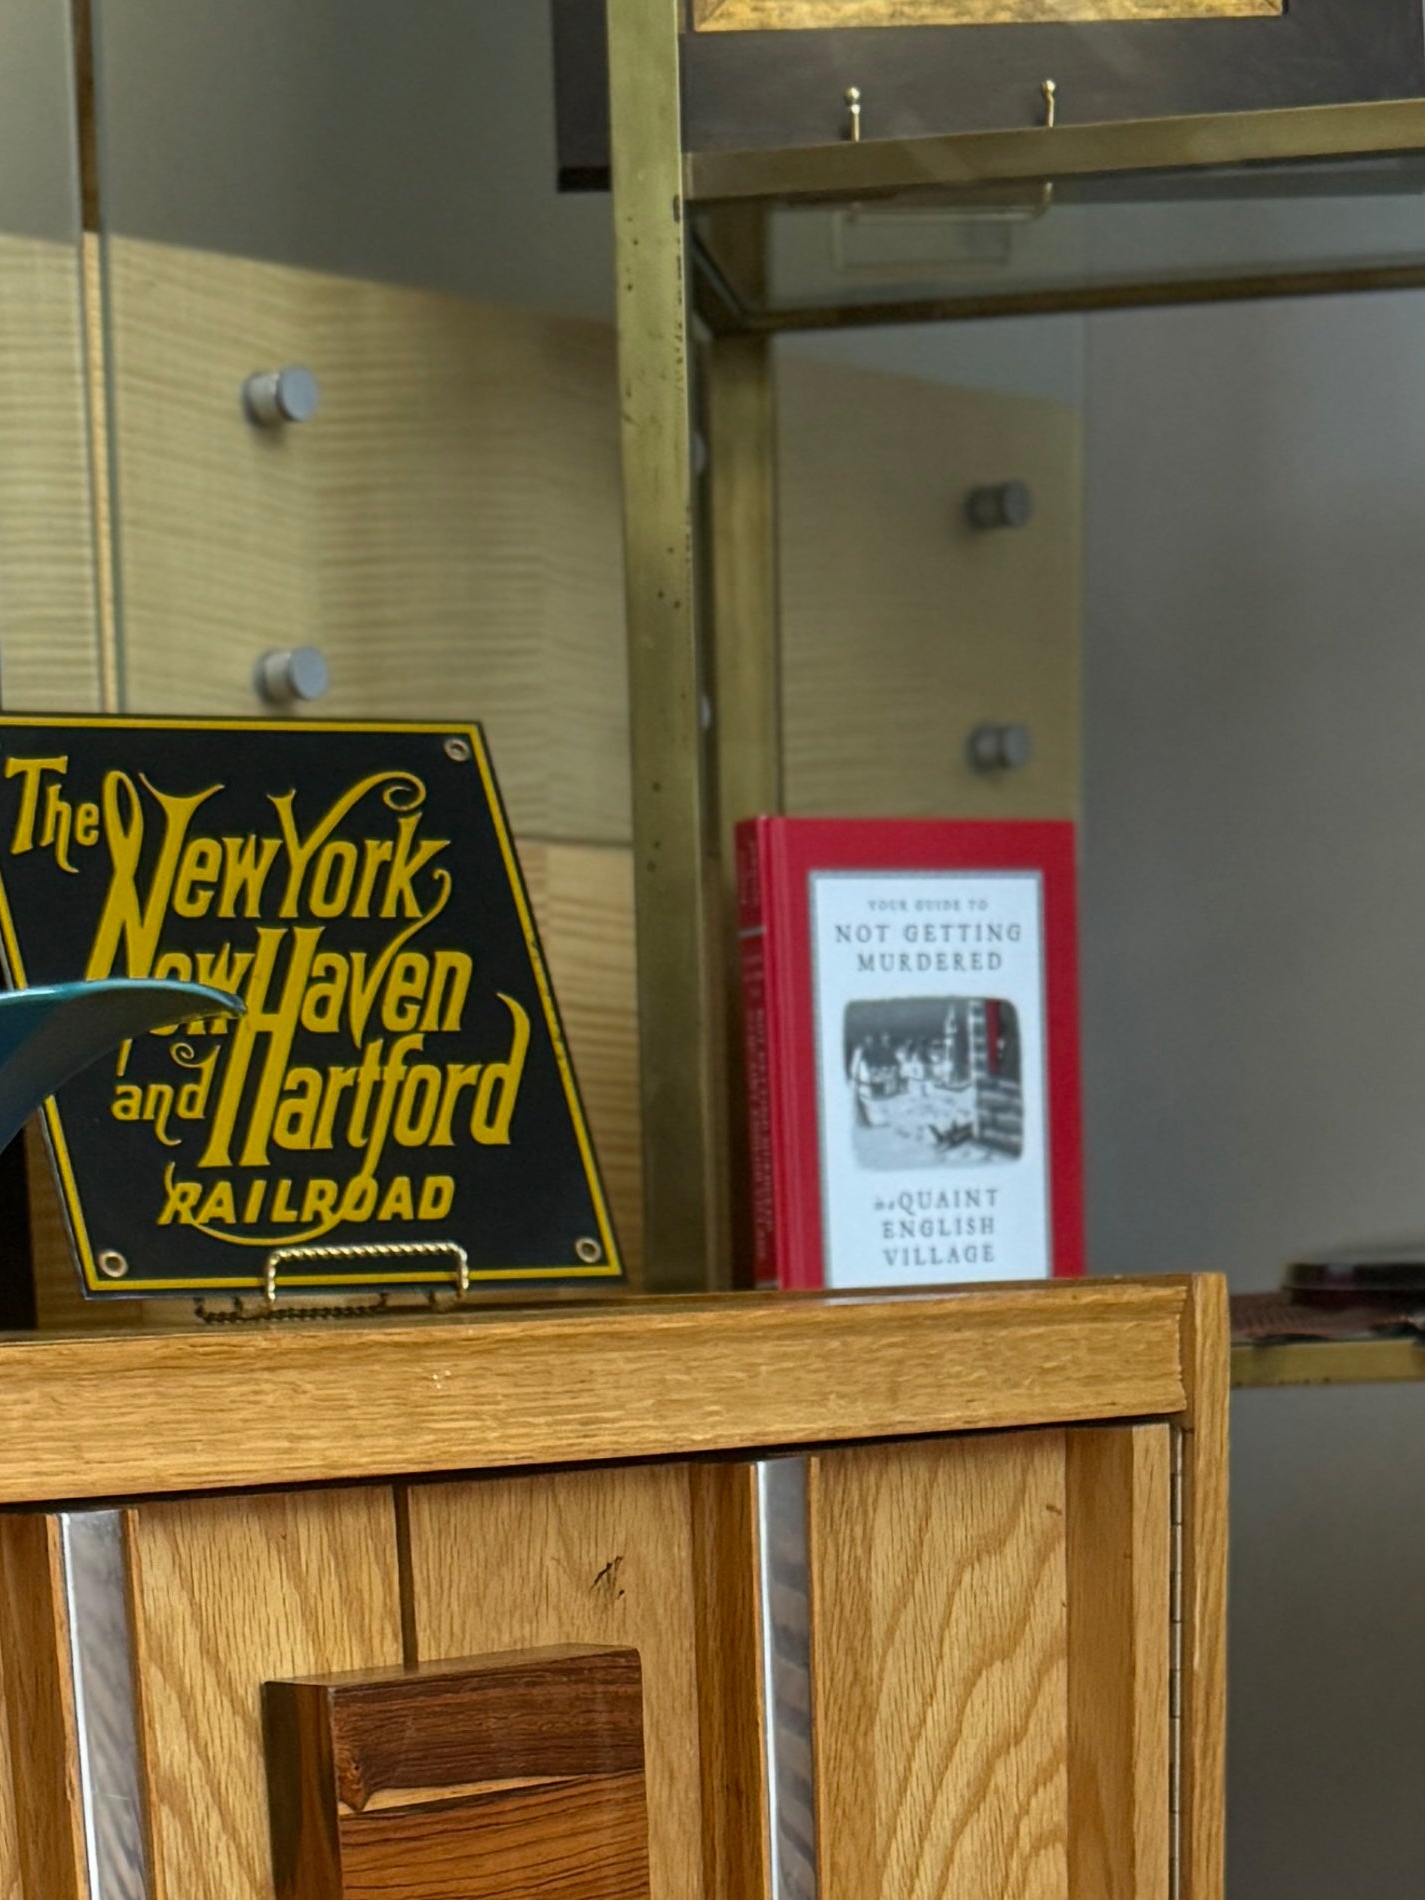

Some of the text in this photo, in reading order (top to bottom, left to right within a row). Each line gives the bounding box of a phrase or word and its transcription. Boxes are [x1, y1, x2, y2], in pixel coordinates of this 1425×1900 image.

[5, 755, 451, 982] The New York
[867, 898, 989, 912] YOUR GUIDE TO
[834, 922, 1022, 943] NOT GETTING
[857, 951, 1003, 972] MURDERED
[231, 900, 473, 1050] Haven
[111, 992, 531, 1175] and Hartford
[156, 1166, 455, 1236] RAILROAD
[898, 1188, 997, 1216] QUAINT
[882, 1216, 995, 1239] ENGLISH
[883, 1243, 995, 1267] VILLAGE
